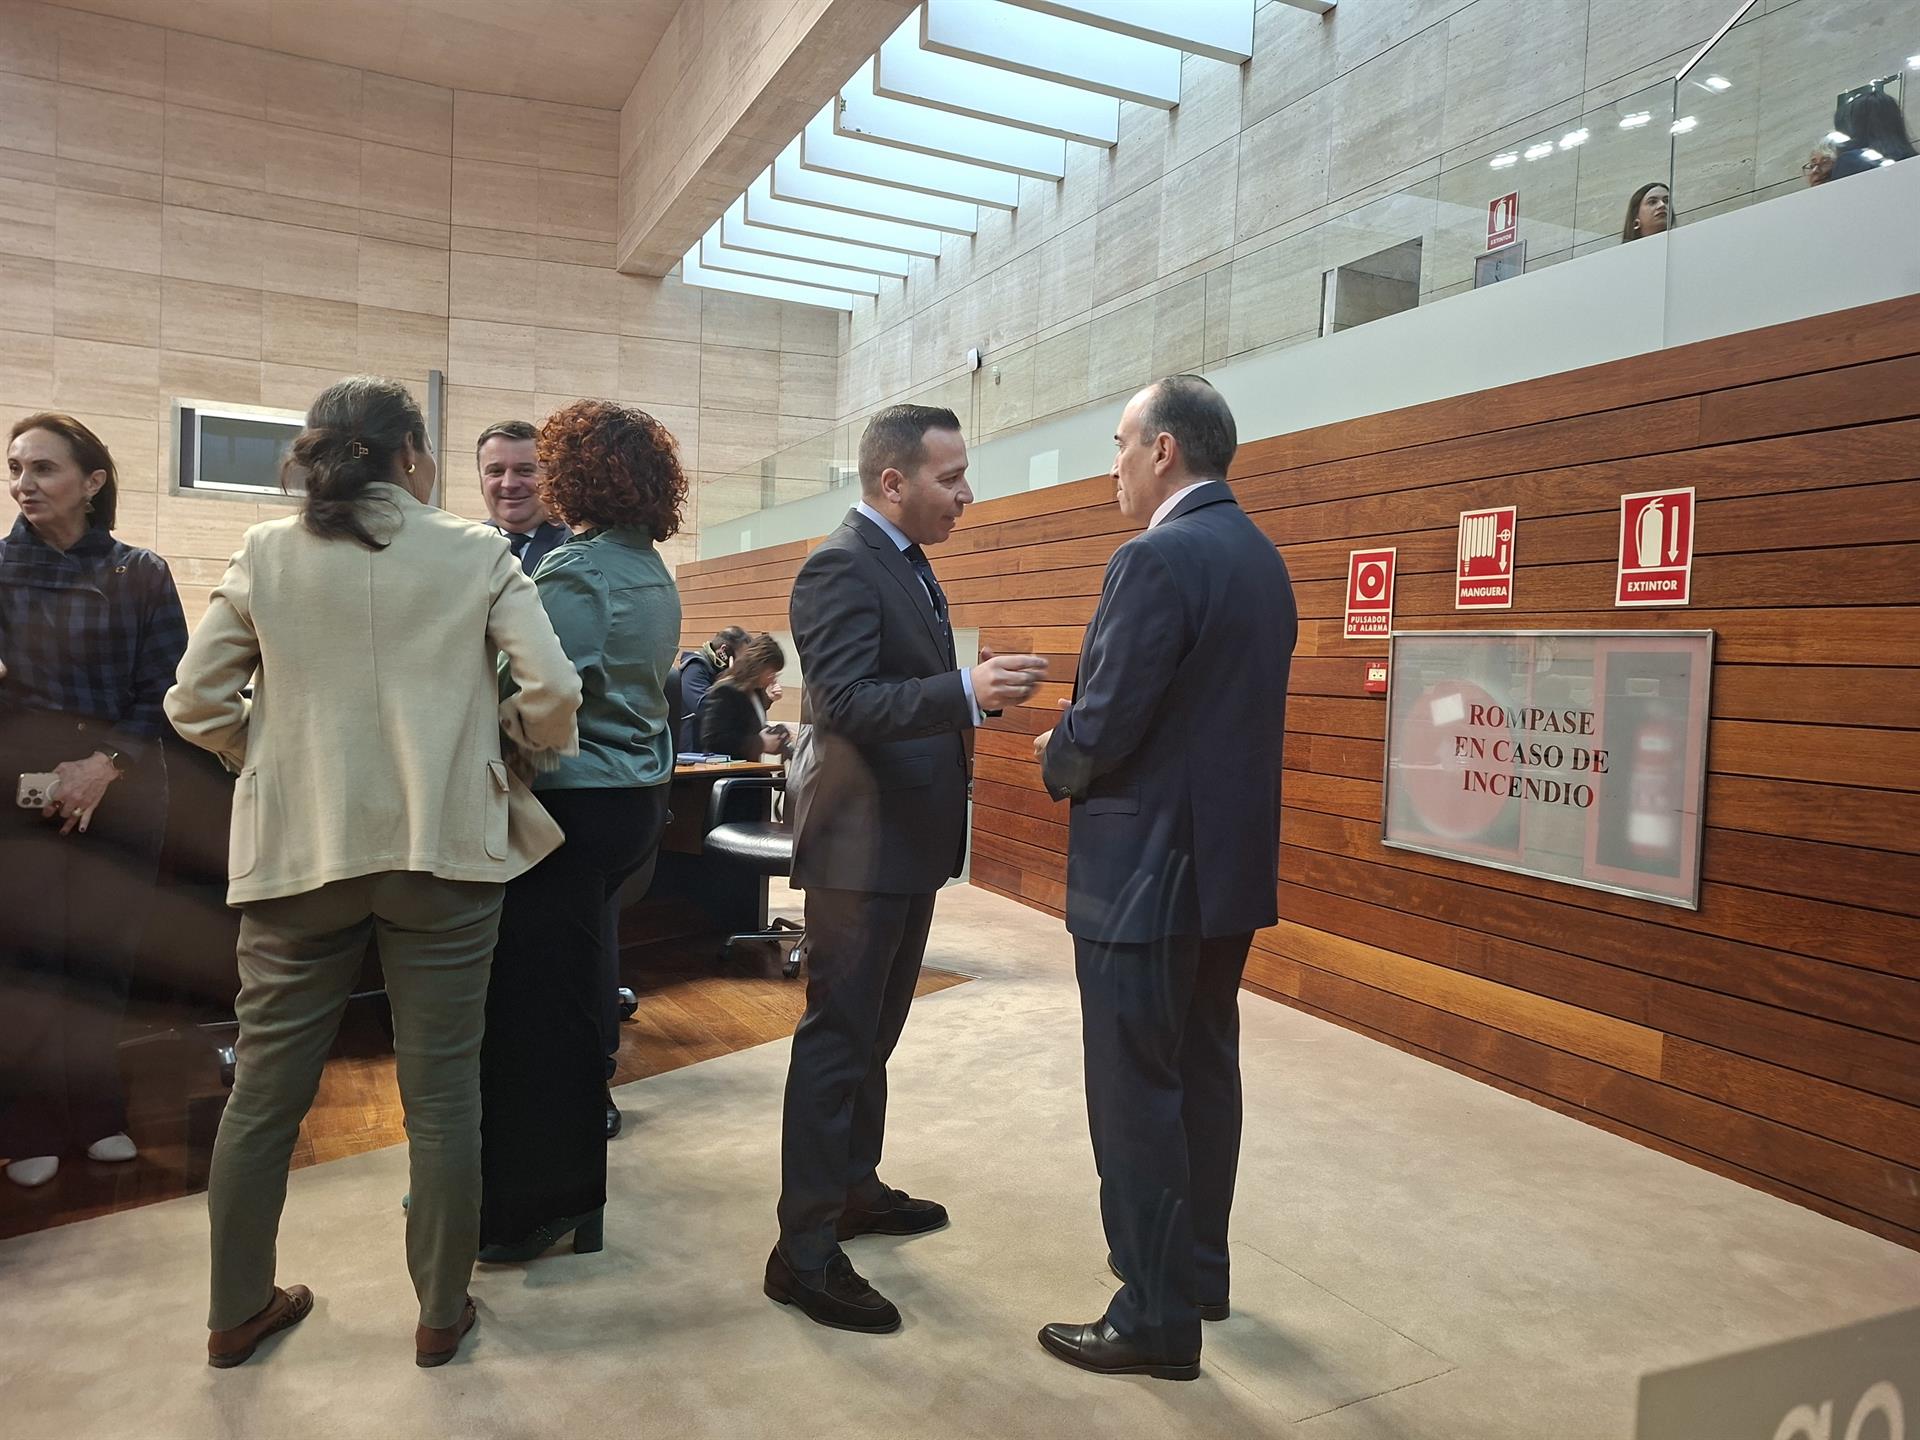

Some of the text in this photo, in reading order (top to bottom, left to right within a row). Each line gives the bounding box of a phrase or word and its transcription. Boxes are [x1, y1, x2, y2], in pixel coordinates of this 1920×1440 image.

[1460, 585, 1508, 598] MANGUERA
[1627, 579, 1678, 592] EXTINTOR
[1350, 615, 1387, 624] PULSADOR
[1347, 623, 1388, 632] DE ALARMA
[1469, 703, 1596, 736] ROMPASE
[1454, 735, 1610, 774] EN CASO DE
[1462, 769, 1595, 809] INCENDIO
